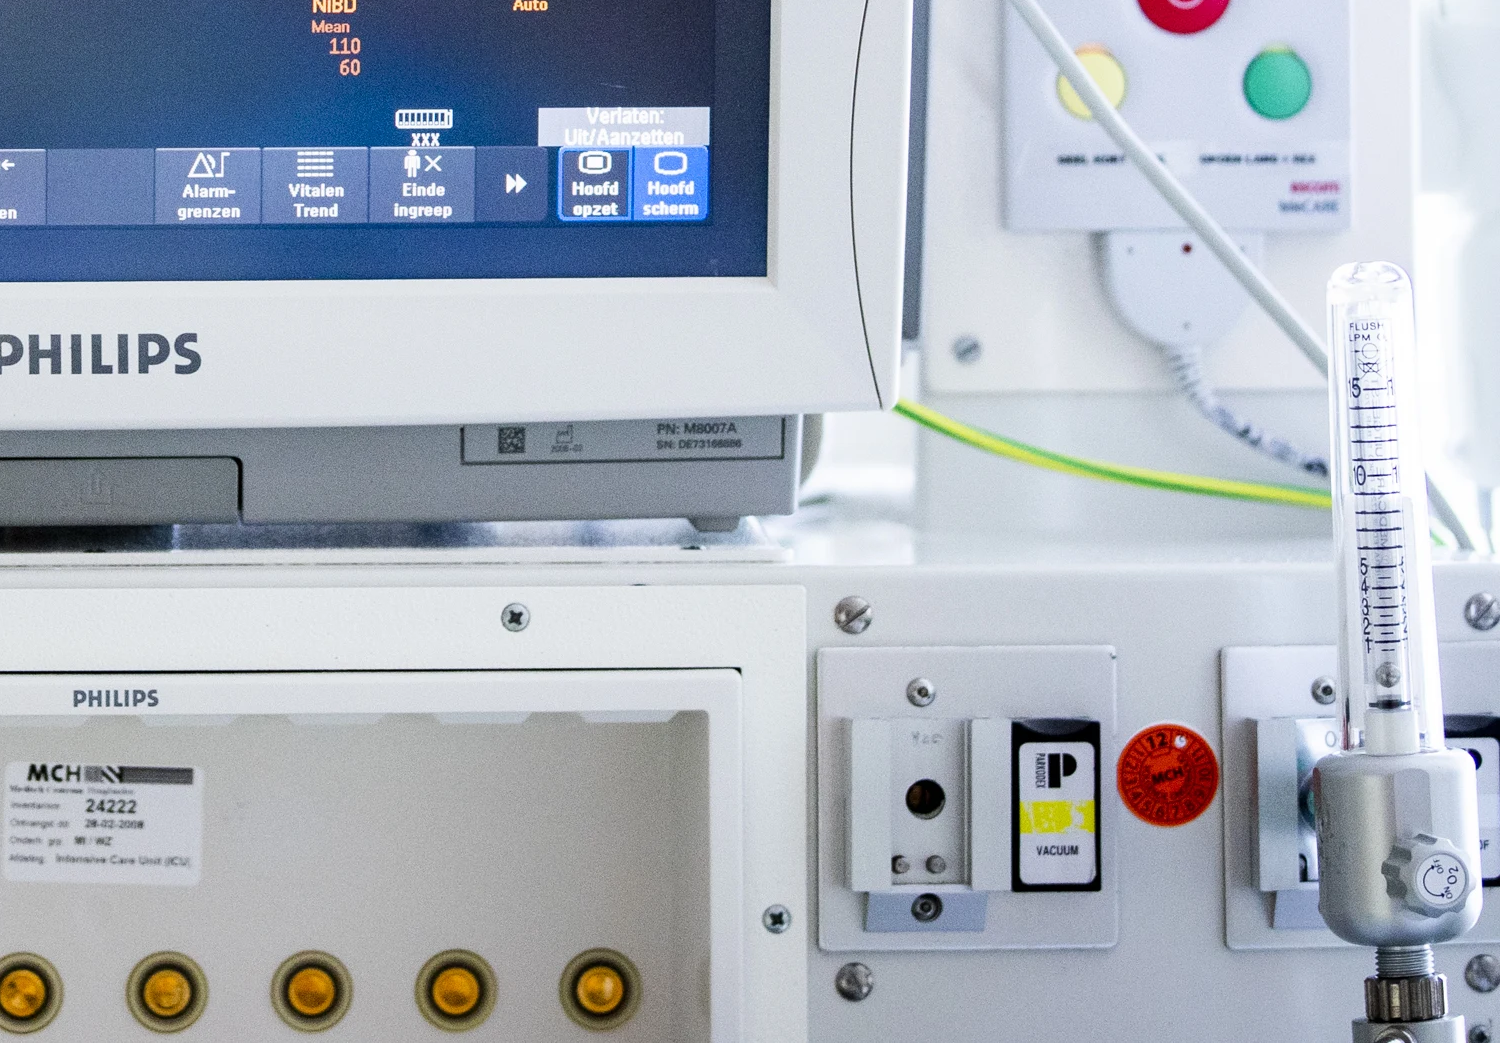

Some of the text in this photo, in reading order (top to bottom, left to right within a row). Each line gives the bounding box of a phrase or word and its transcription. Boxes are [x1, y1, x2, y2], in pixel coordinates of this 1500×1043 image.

[312, 20, 350, 34] Mean
[329, 38, 361, 55] 110
[340, 59, 361, 76] 60
[586, 108, 665, 124] Verlaten:
[564, 128, 685, 146] Uit/Aanzetten
[182, 184, 236, 200] Alarm-
[288, 182, 344, 198] Vitalen
[402, 182, 446, 197] Einde
[572, 180, 619, 196] Hoofd
[647, 180, 695, 196] Hoofd
[177, 204, 241, 221] grenzen
[294, 202, 338, 218] Trend
[394, 202, 452, 220] ingreep
[573, 201, 618, 218] opzet
[642, 200, 699, 216] scherm
[1350, 322, 1384, 331] FLUSH
[1360, 558, 1368, 576] 5
[1361, 577, 1369, 595] 4
[1362, 598, 1370, 616] 3
[1362, 617, 1371, 636] 2
[73, 689, 160, 708] PHILIPS
[1146, 732, 1168, 749] 12
[27, 764, 82, 782] MCH
[1152, 766, 1184, 784] MCH
[86, 799, 137, 814] 24222
[1036, 845, 1079, 856] VACUUM
[110, 855, 136, 864] Care
[1444, 886, 1453, 900] ON
